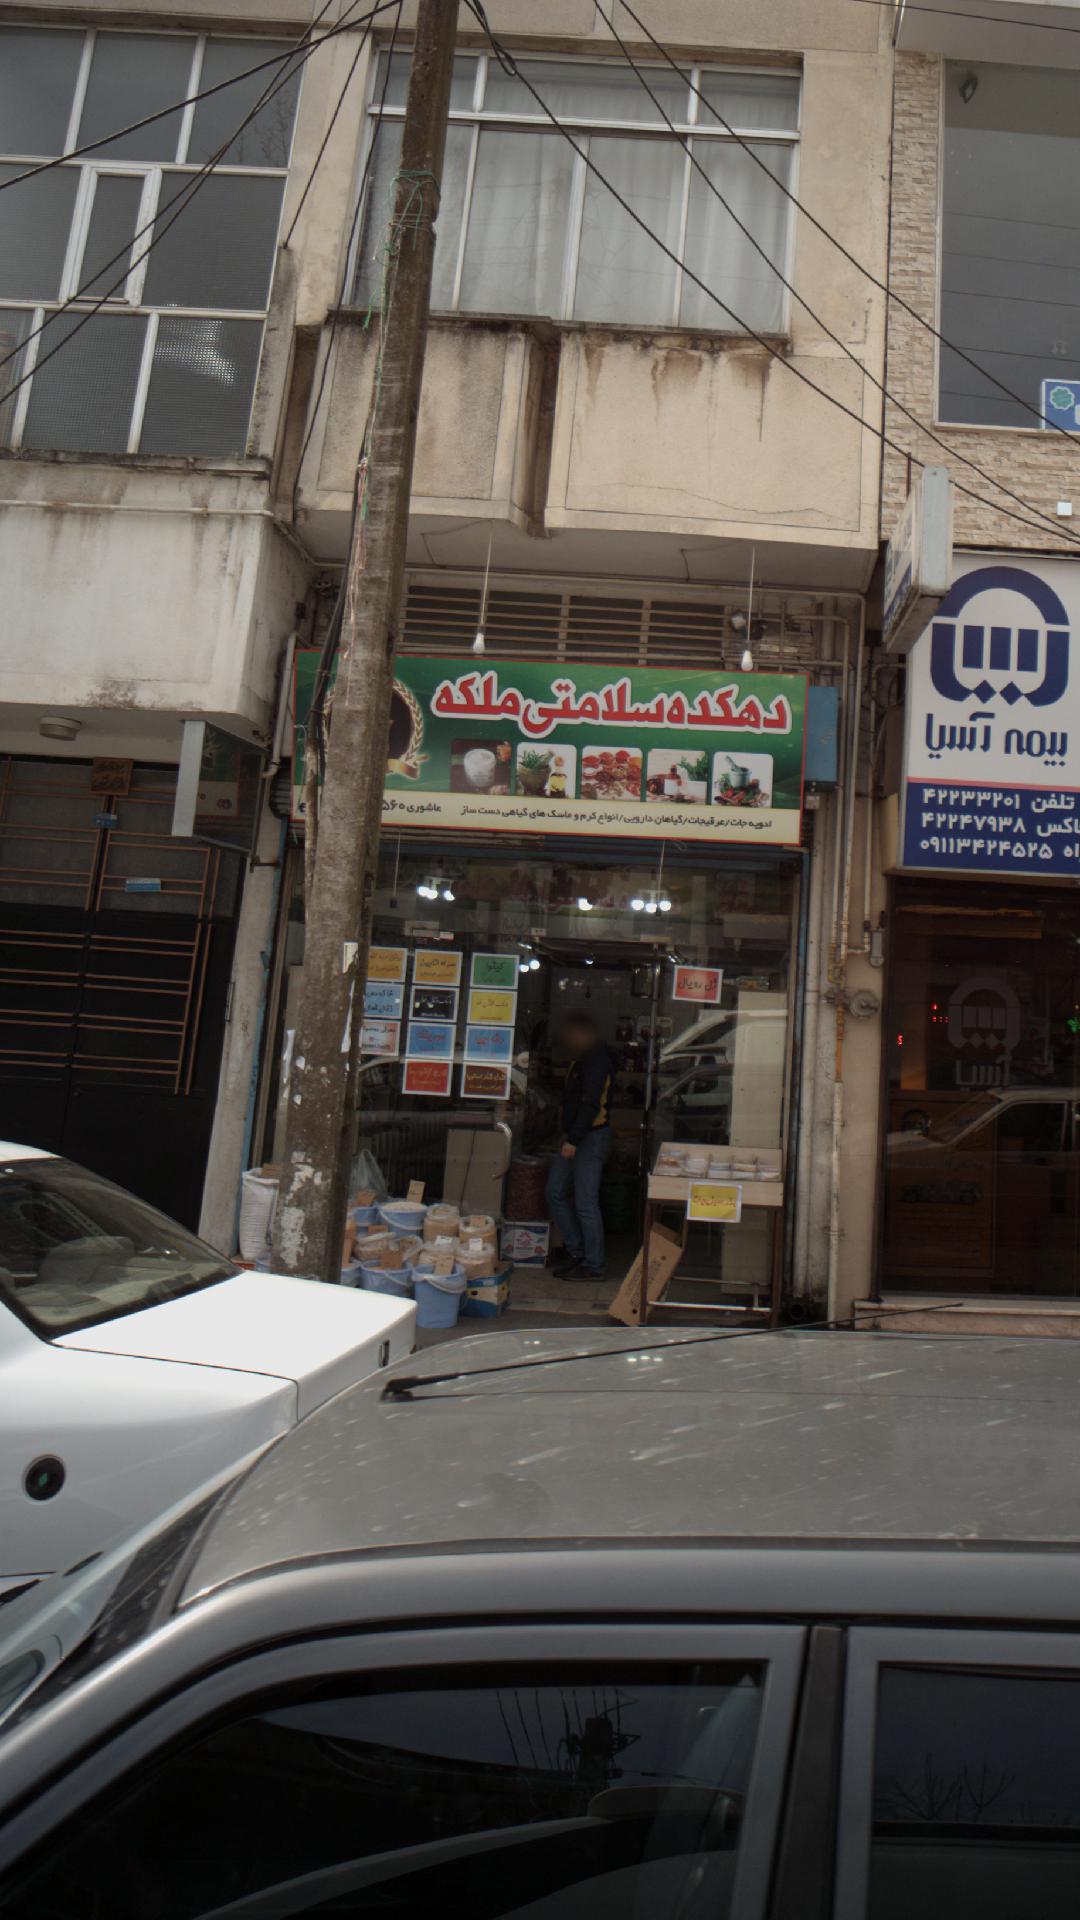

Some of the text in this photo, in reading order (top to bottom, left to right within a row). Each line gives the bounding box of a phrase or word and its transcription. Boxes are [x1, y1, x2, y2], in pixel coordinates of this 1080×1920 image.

[431, 672, 791, 738] دهکده سلامتی ملکه
[925, 711, 1068, 767] بیمه آسیا
[382, 799, 406, 812] ۵۶۰
[923, 788, 1076, 813] تلفن ۴۲۲۳۳۲۰۱
[921, 812, 1080, 838] اکس ۴۲۲۴۷۹۳۸
[920, 836, 1053, 860] ۰۹۱۱۳۴۲۴۵۲۵
[955, 1054, 1013, 1092] آسیا
